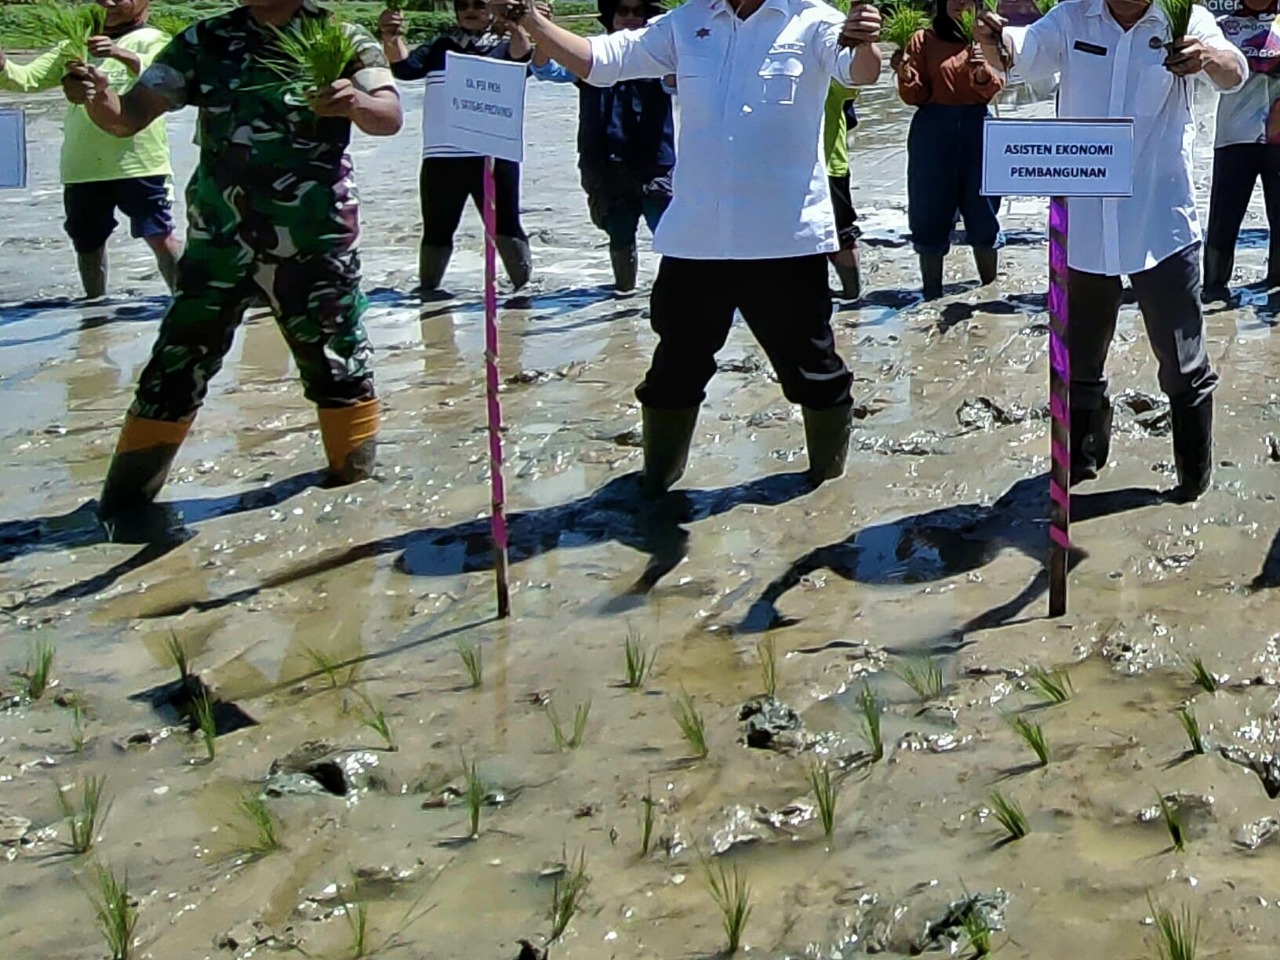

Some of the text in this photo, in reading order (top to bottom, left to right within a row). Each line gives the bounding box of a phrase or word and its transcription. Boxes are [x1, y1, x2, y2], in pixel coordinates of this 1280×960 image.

[1004, 144, 1113, 155] ASISTEN EKONOMI
[1010, 166, 1106, 178] PEMBANGUNAN
